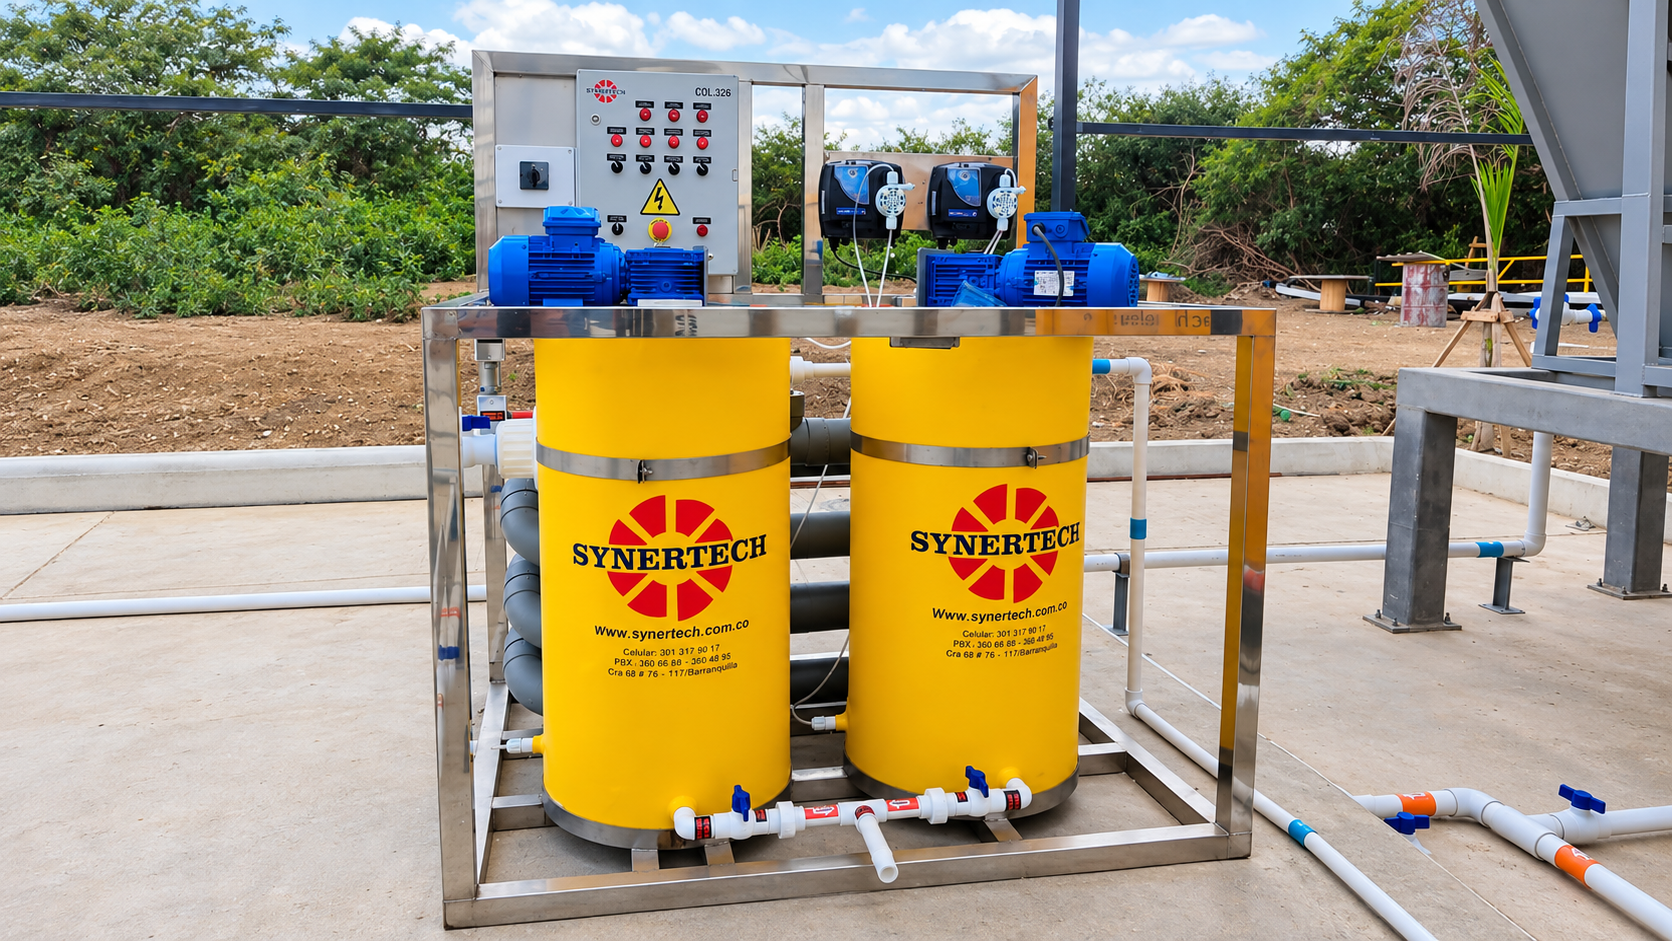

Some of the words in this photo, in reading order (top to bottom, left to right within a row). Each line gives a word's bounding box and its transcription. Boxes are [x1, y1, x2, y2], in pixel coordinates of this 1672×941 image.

[694, 86, 732, 98] COL.326
[911, 522, 1081, 557] SYNERTECH
[572, 534, 767, 571] SYNERTECH
[996, 629, 1011, 638] 301
[1012, 628, 1026, 637] 317
[1038, 624, 1046, 633] 17
[659, 648, 676, 657] 301
[678, 647, 695, 656] 317
[697, 645, 708, 655] 90
[710, 643, 720, 652] 17
[977, 641, 993, 649] 360
[639, 659, 655, 668] 360
[657, 659, 669, 667] 66
[671, 658, 682, 667] 88
[690, 657, 707, 666] 360
[708, 654, 719, 663] 48
[721, 652, 732, 661] 95
[945, 649, 962, 658] Cra
[963, 650, 974, 659] 68
[985, 651, 996, 659] 76
[607, 667, 623, 677] Cra
[625, 669, 636, 678] 68
[647, 670, 659, 678] 76
